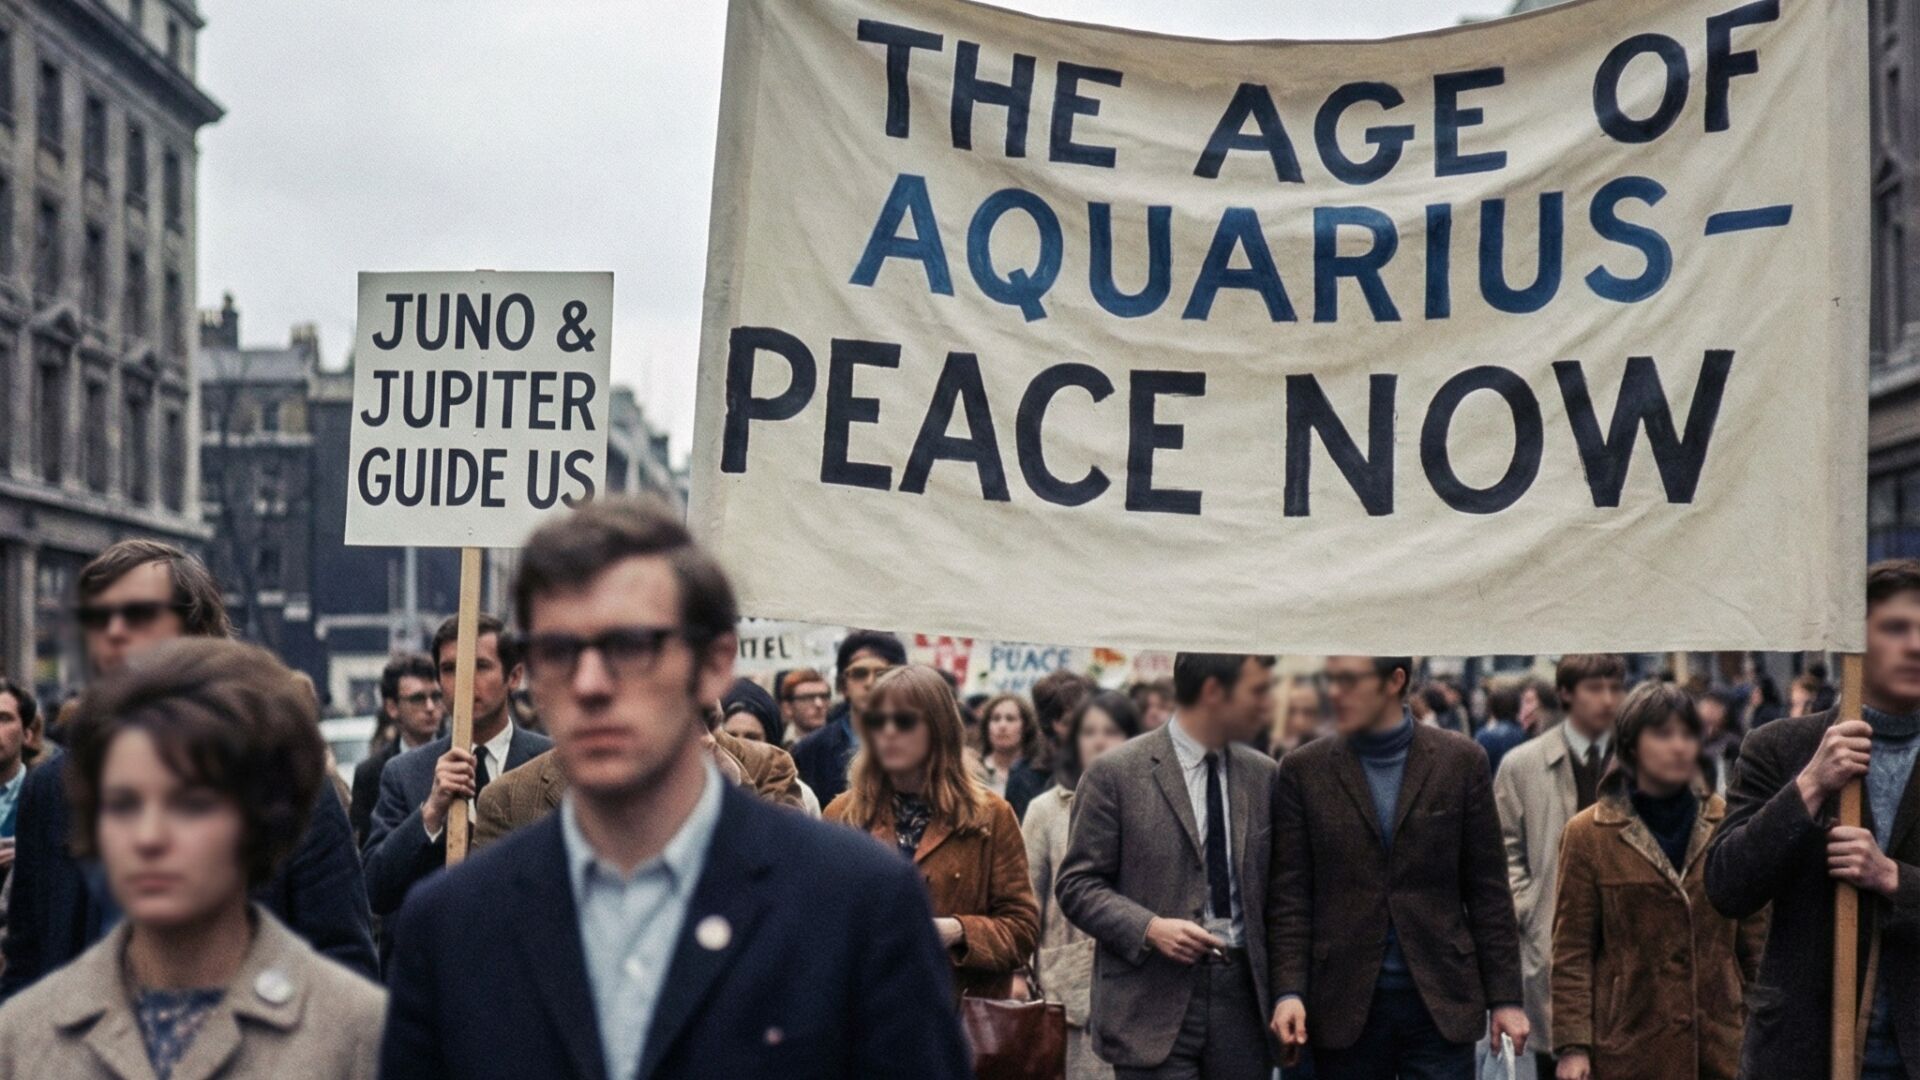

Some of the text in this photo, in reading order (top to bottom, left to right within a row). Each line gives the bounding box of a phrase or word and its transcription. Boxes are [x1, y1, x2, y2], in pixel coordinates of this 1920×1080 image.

[856, 0, 1781, 186] THE AGE OF
[372, 292, 596, 353] JUNO &
[359, 370, 597, 431] JUPITER
[720, 325, 1736, 518] PEACE NOW
[357, 446, 597, 511] GUIDE US
